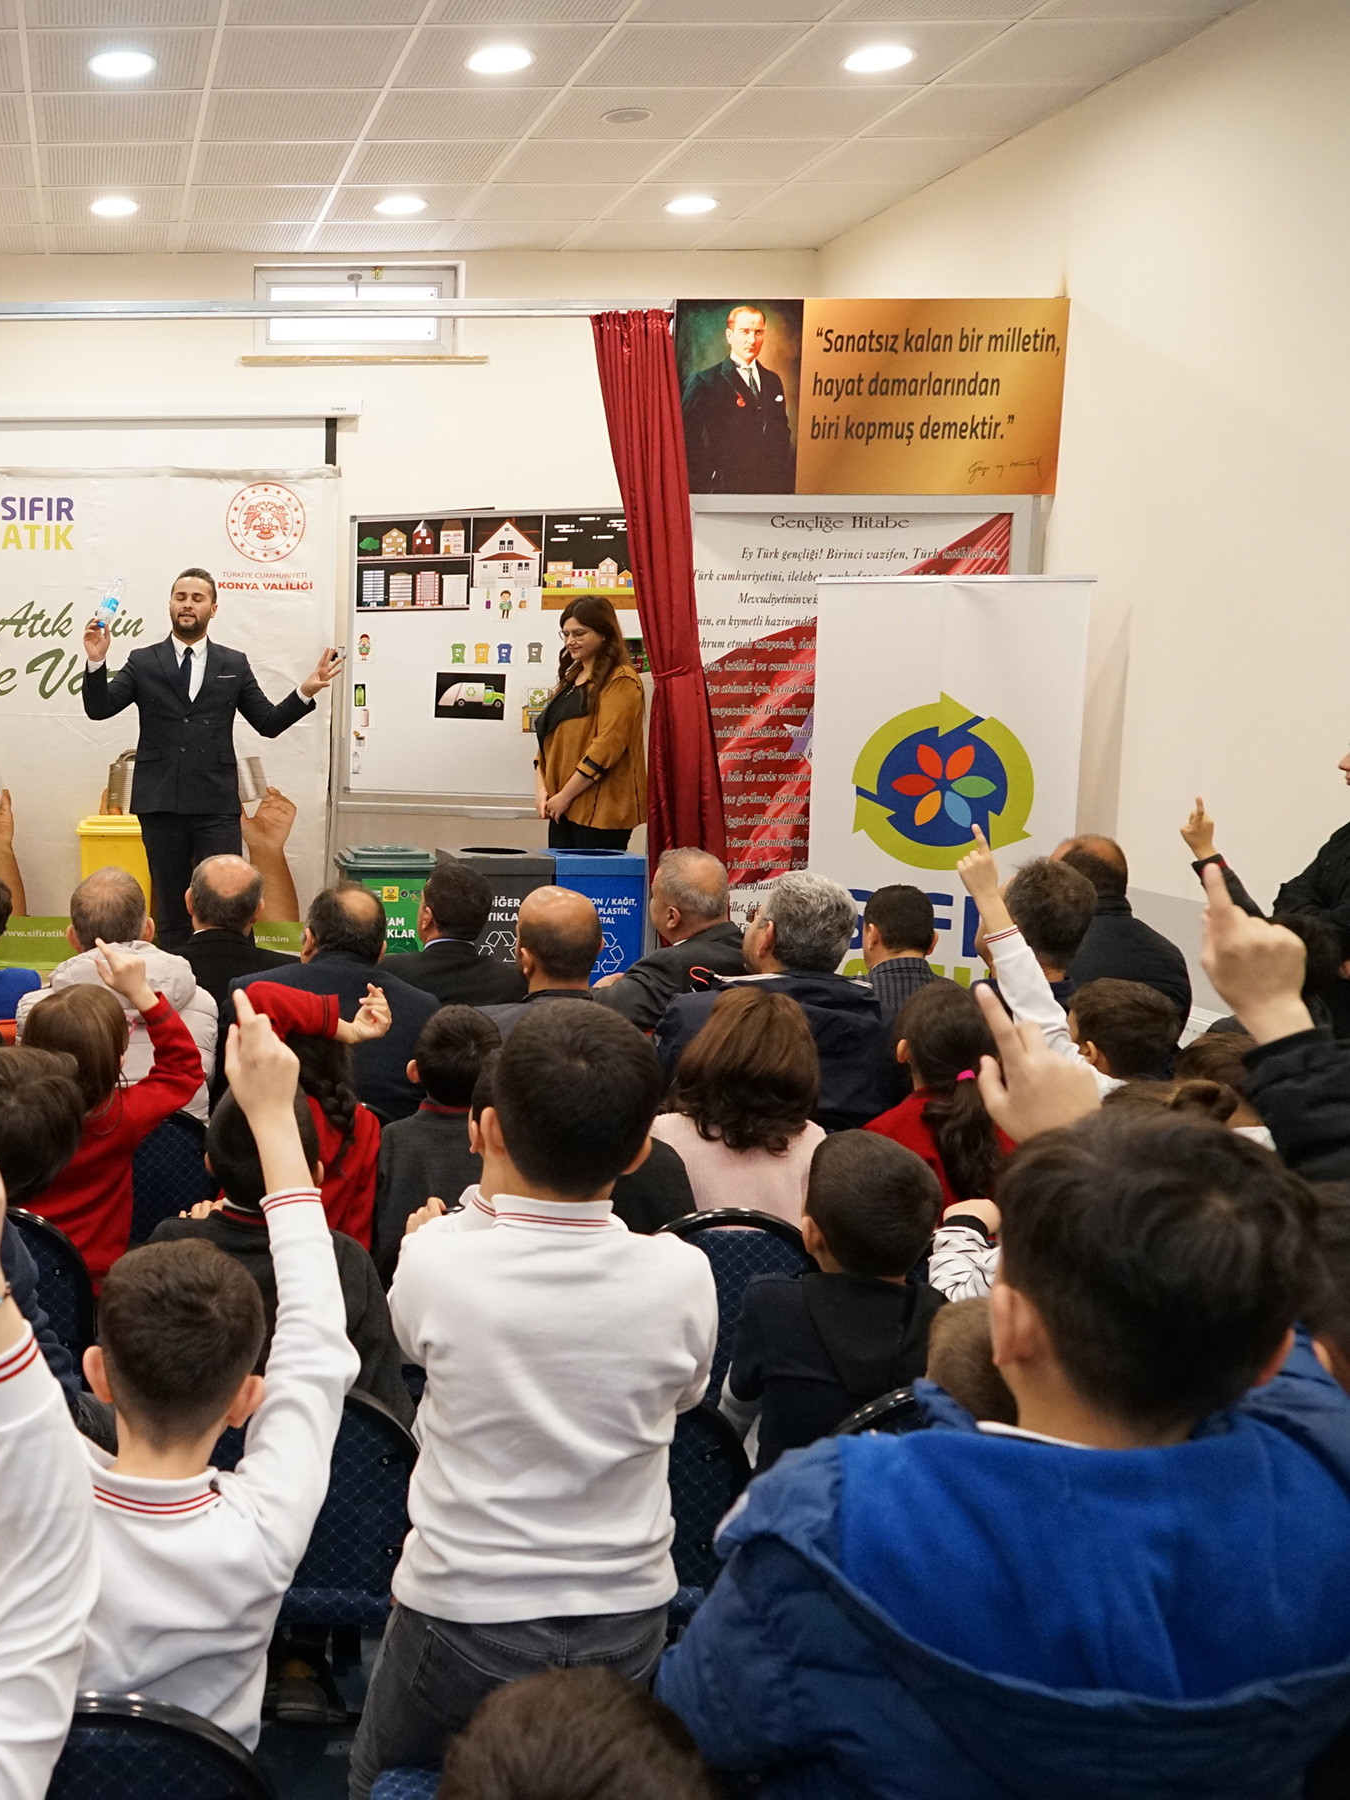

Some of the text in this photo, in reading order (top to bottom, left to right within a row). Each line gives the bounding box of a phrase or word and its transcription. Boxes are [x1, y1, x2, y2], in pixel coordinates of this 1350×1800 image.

[903, 328, 953, 352] kalan
[958, 327, 983, 352] bir
[987, 327, 1060, 357] milletin,
[812, 371, 1000, 402] hayat damarlarından
[810, 415, 840, 440] biri
[844, 415, 914, 446] kopmuş
[1, 496, 74, 521] SIFIR
[771, 515, 910, 533] Gençliğe Hitabe
[1, 524, 74, 550] ATIK
[741, 548, 753, 561] Ey
[757, 548, 779, 560] Türk
[781, 548, 823, 561] gençliği!
[826, 549, 863, 560] Birinci
[866, 548, 909, 560] vazifen,
[913, 548, 939, 559] Türk
[254, 571, 308, 579] CUMHURİYETİ
[716, 569, 785, 583] cumhuriyetini,
[218, 580, 313, 590] KONYA VALİLİĞİ
[728, 615, 763, 628] kıymetli
[492, 896, 521, 907] İĞER
[611, 896, 637, 907] KAĞIT,
[598, 907, 631, 916] PLASTİK,
[386, 929, 415, 938] KLAR
